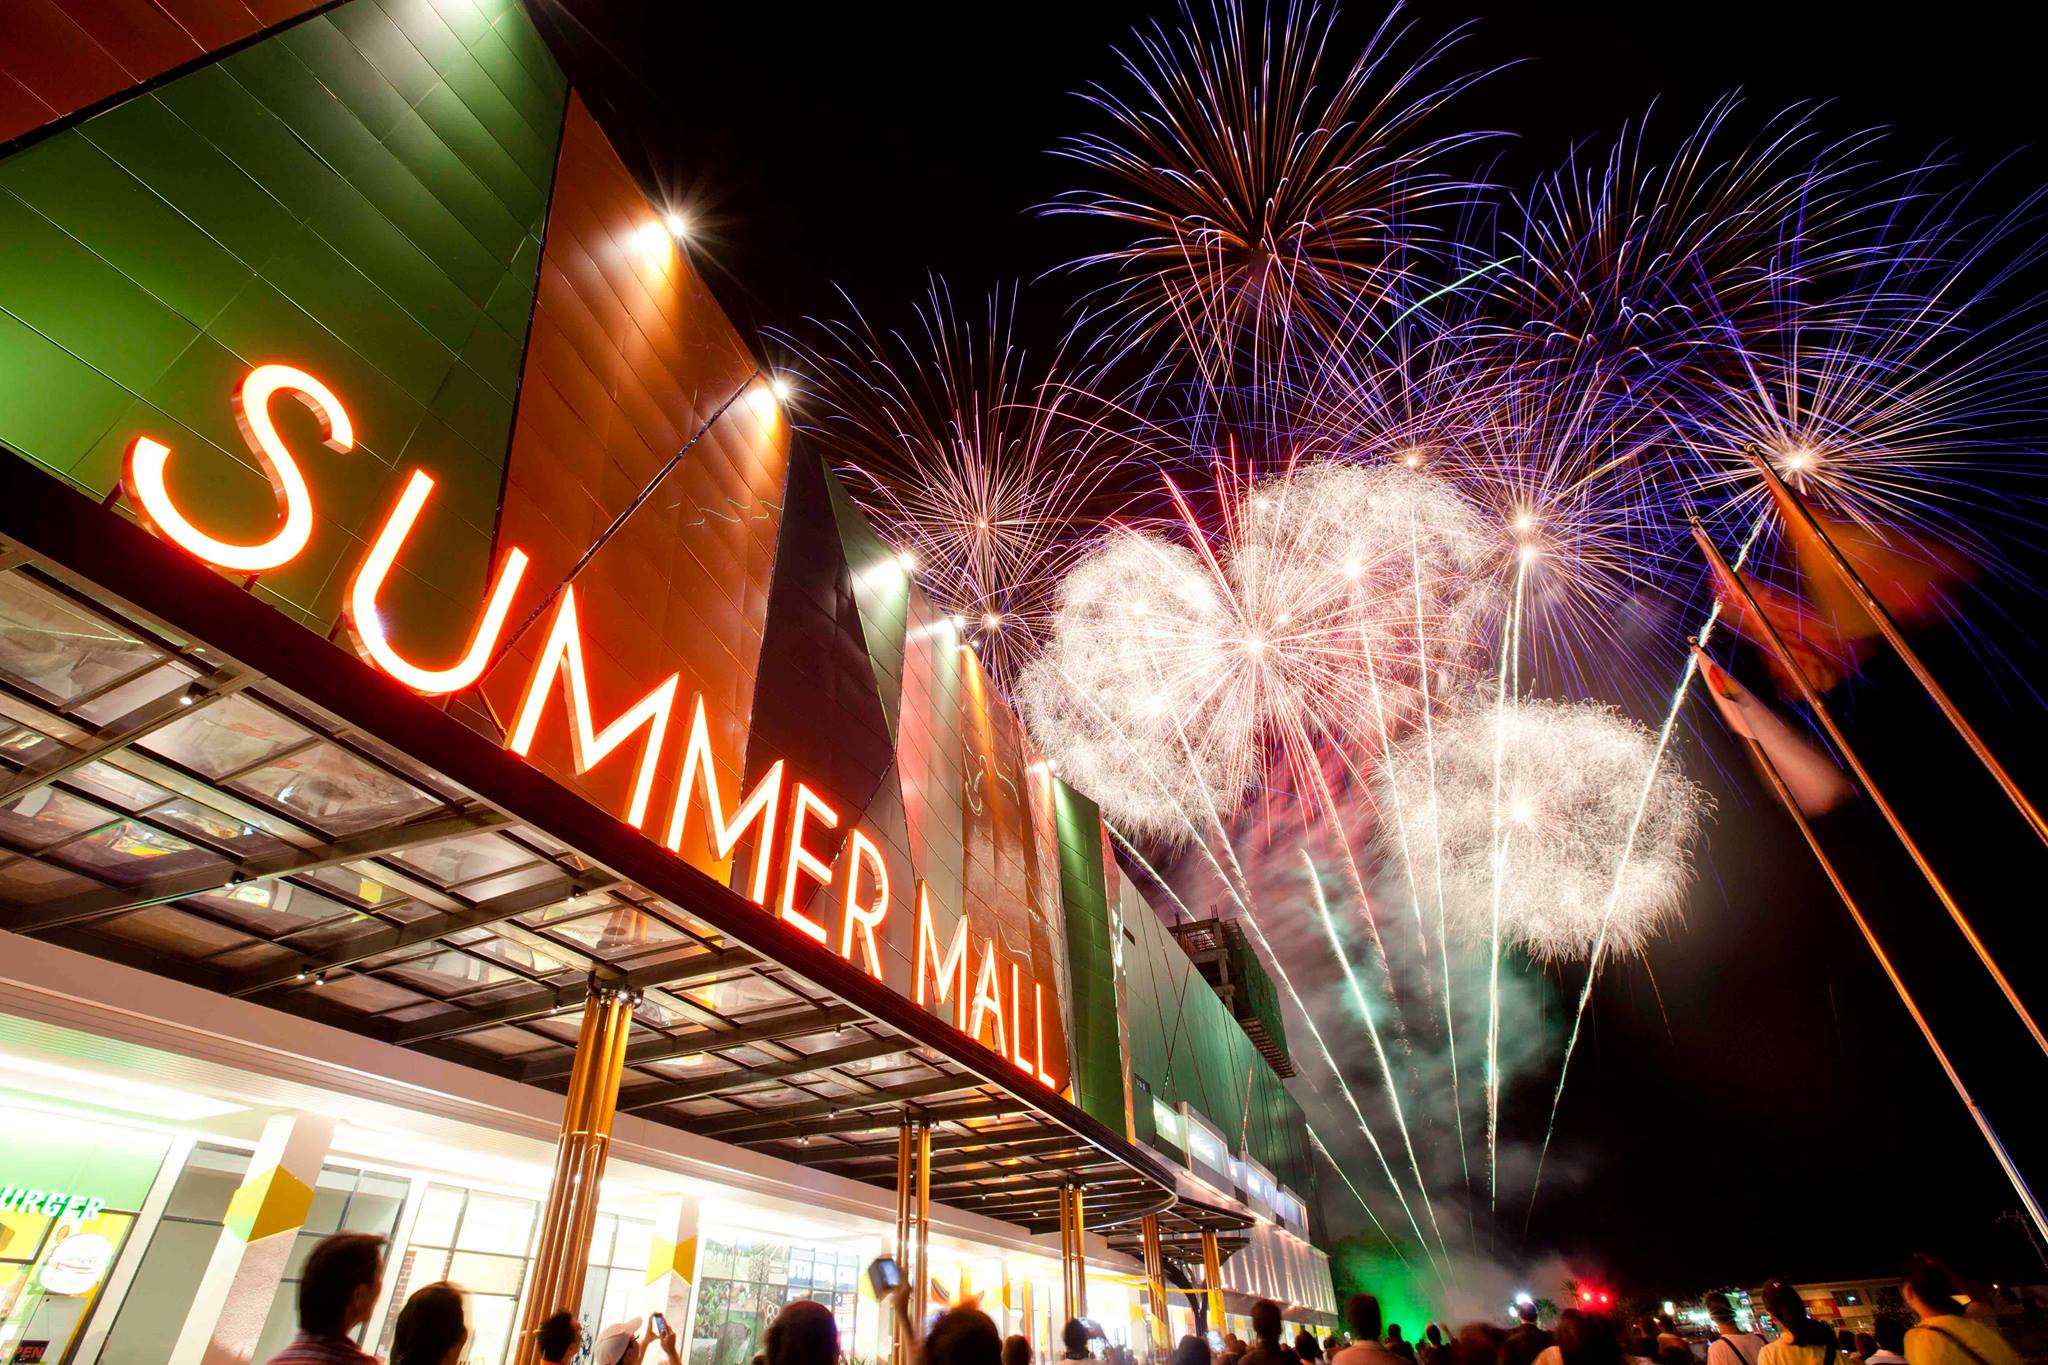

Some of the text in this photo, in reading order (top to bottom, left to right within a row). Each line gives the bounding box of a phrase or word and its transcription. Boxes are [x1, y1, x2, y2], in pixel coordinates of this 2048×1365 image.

[122, 364, 1056, 1089] SUMMER MALL
[15, 1345, 45, 1359] PEN
